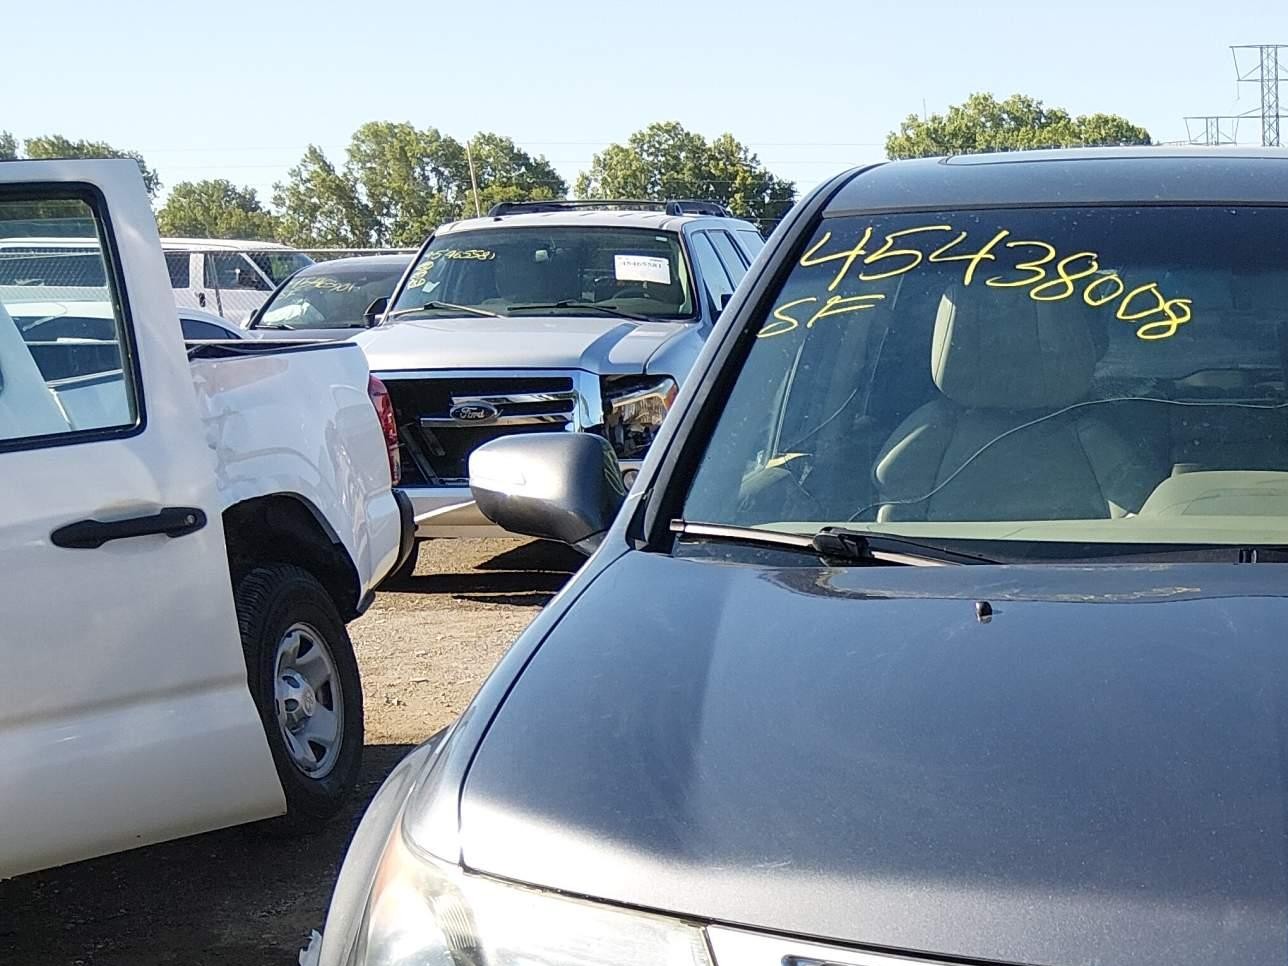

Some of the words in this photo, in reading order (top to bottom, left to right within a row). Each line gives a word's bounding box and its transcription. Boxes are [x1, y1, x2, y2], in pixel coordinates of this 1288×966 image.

[800, 225, 1193, 340] 45438008
[757, 294, 886, 339] SF
[459, 406, 486, 419] Ford
